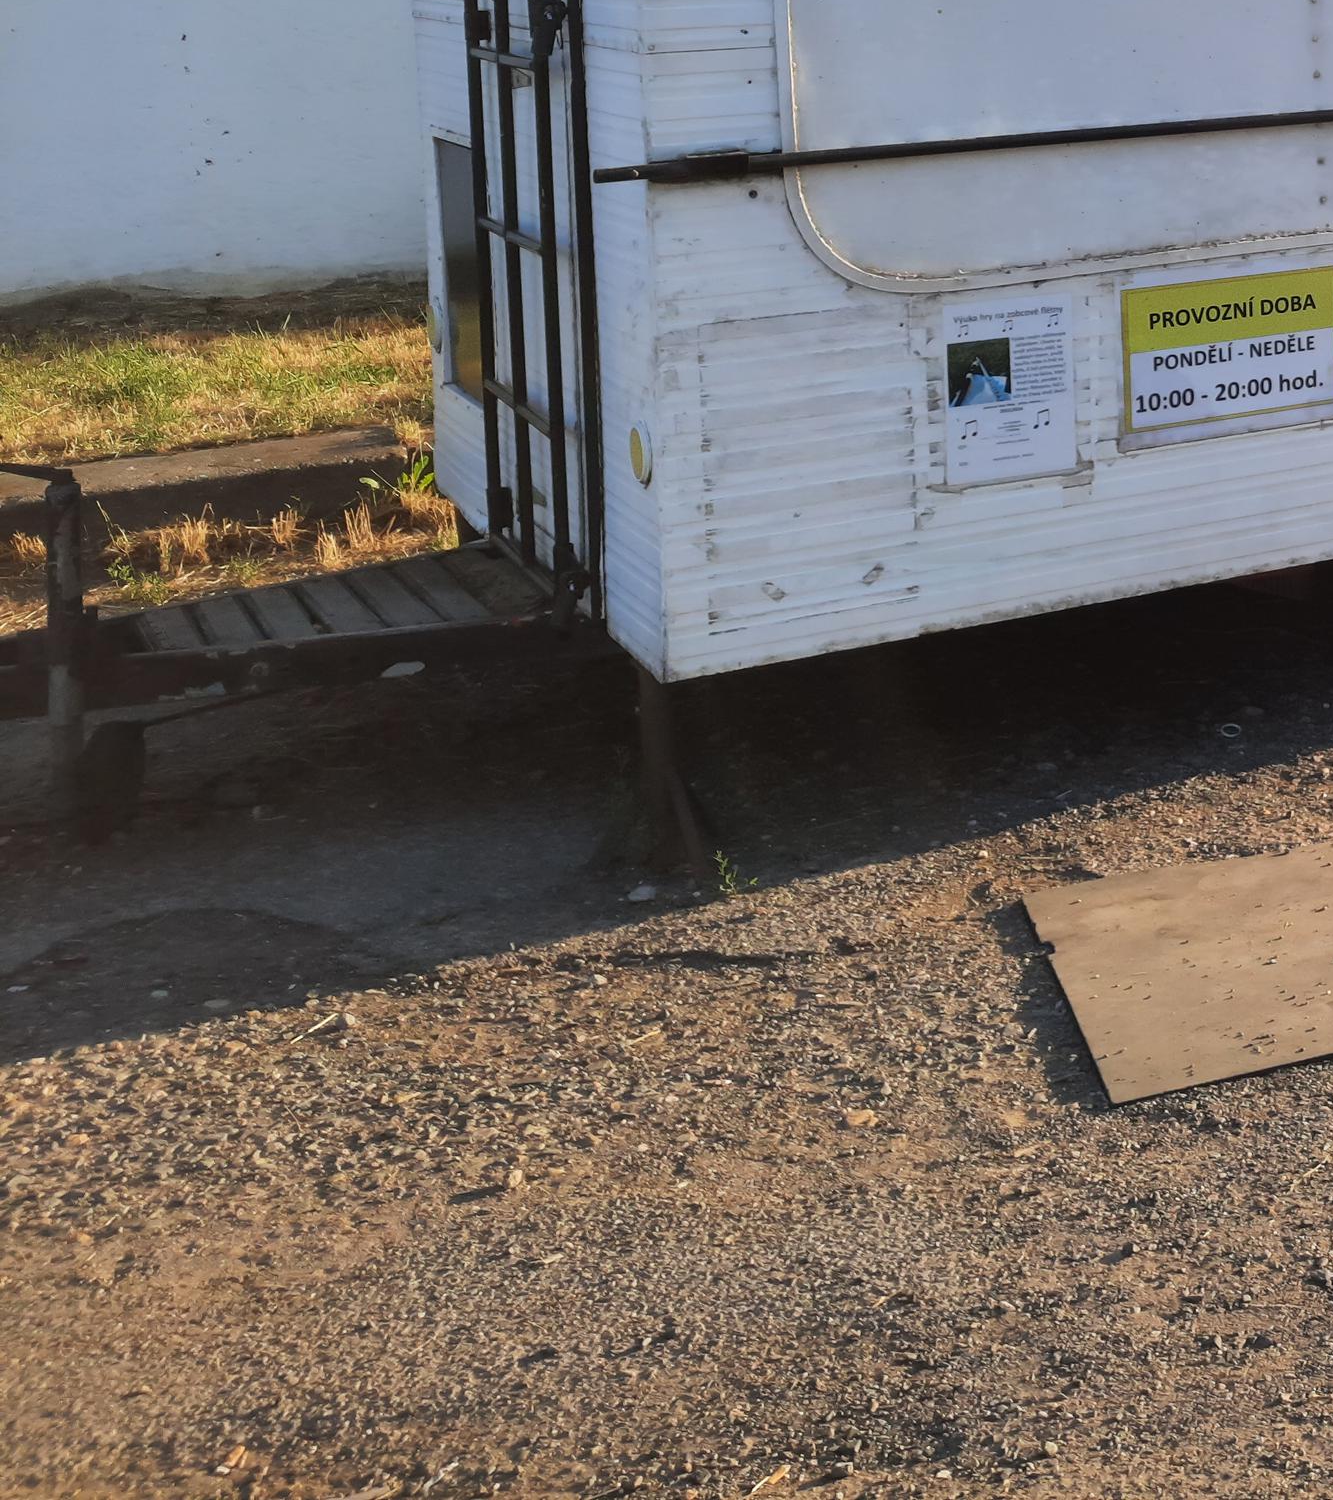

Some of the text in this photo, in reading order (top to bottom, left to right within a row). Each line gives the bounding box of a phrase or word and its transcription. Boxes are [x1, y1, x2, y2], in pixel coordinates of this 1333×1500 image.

[979, 313, 993, 321] hry
[1149, 293, 1317, 330] PROVOZNÍ DOBA
[1153, 342, 1233, 371] PONDĚLÍ
[1249, 334, 1316, 358] NEDĚLE
[1135, 388, 1195, 414] 10:00
[1215, 376, 1272, 402] 20:00
[1279, 369, 1324, 393] hod.
